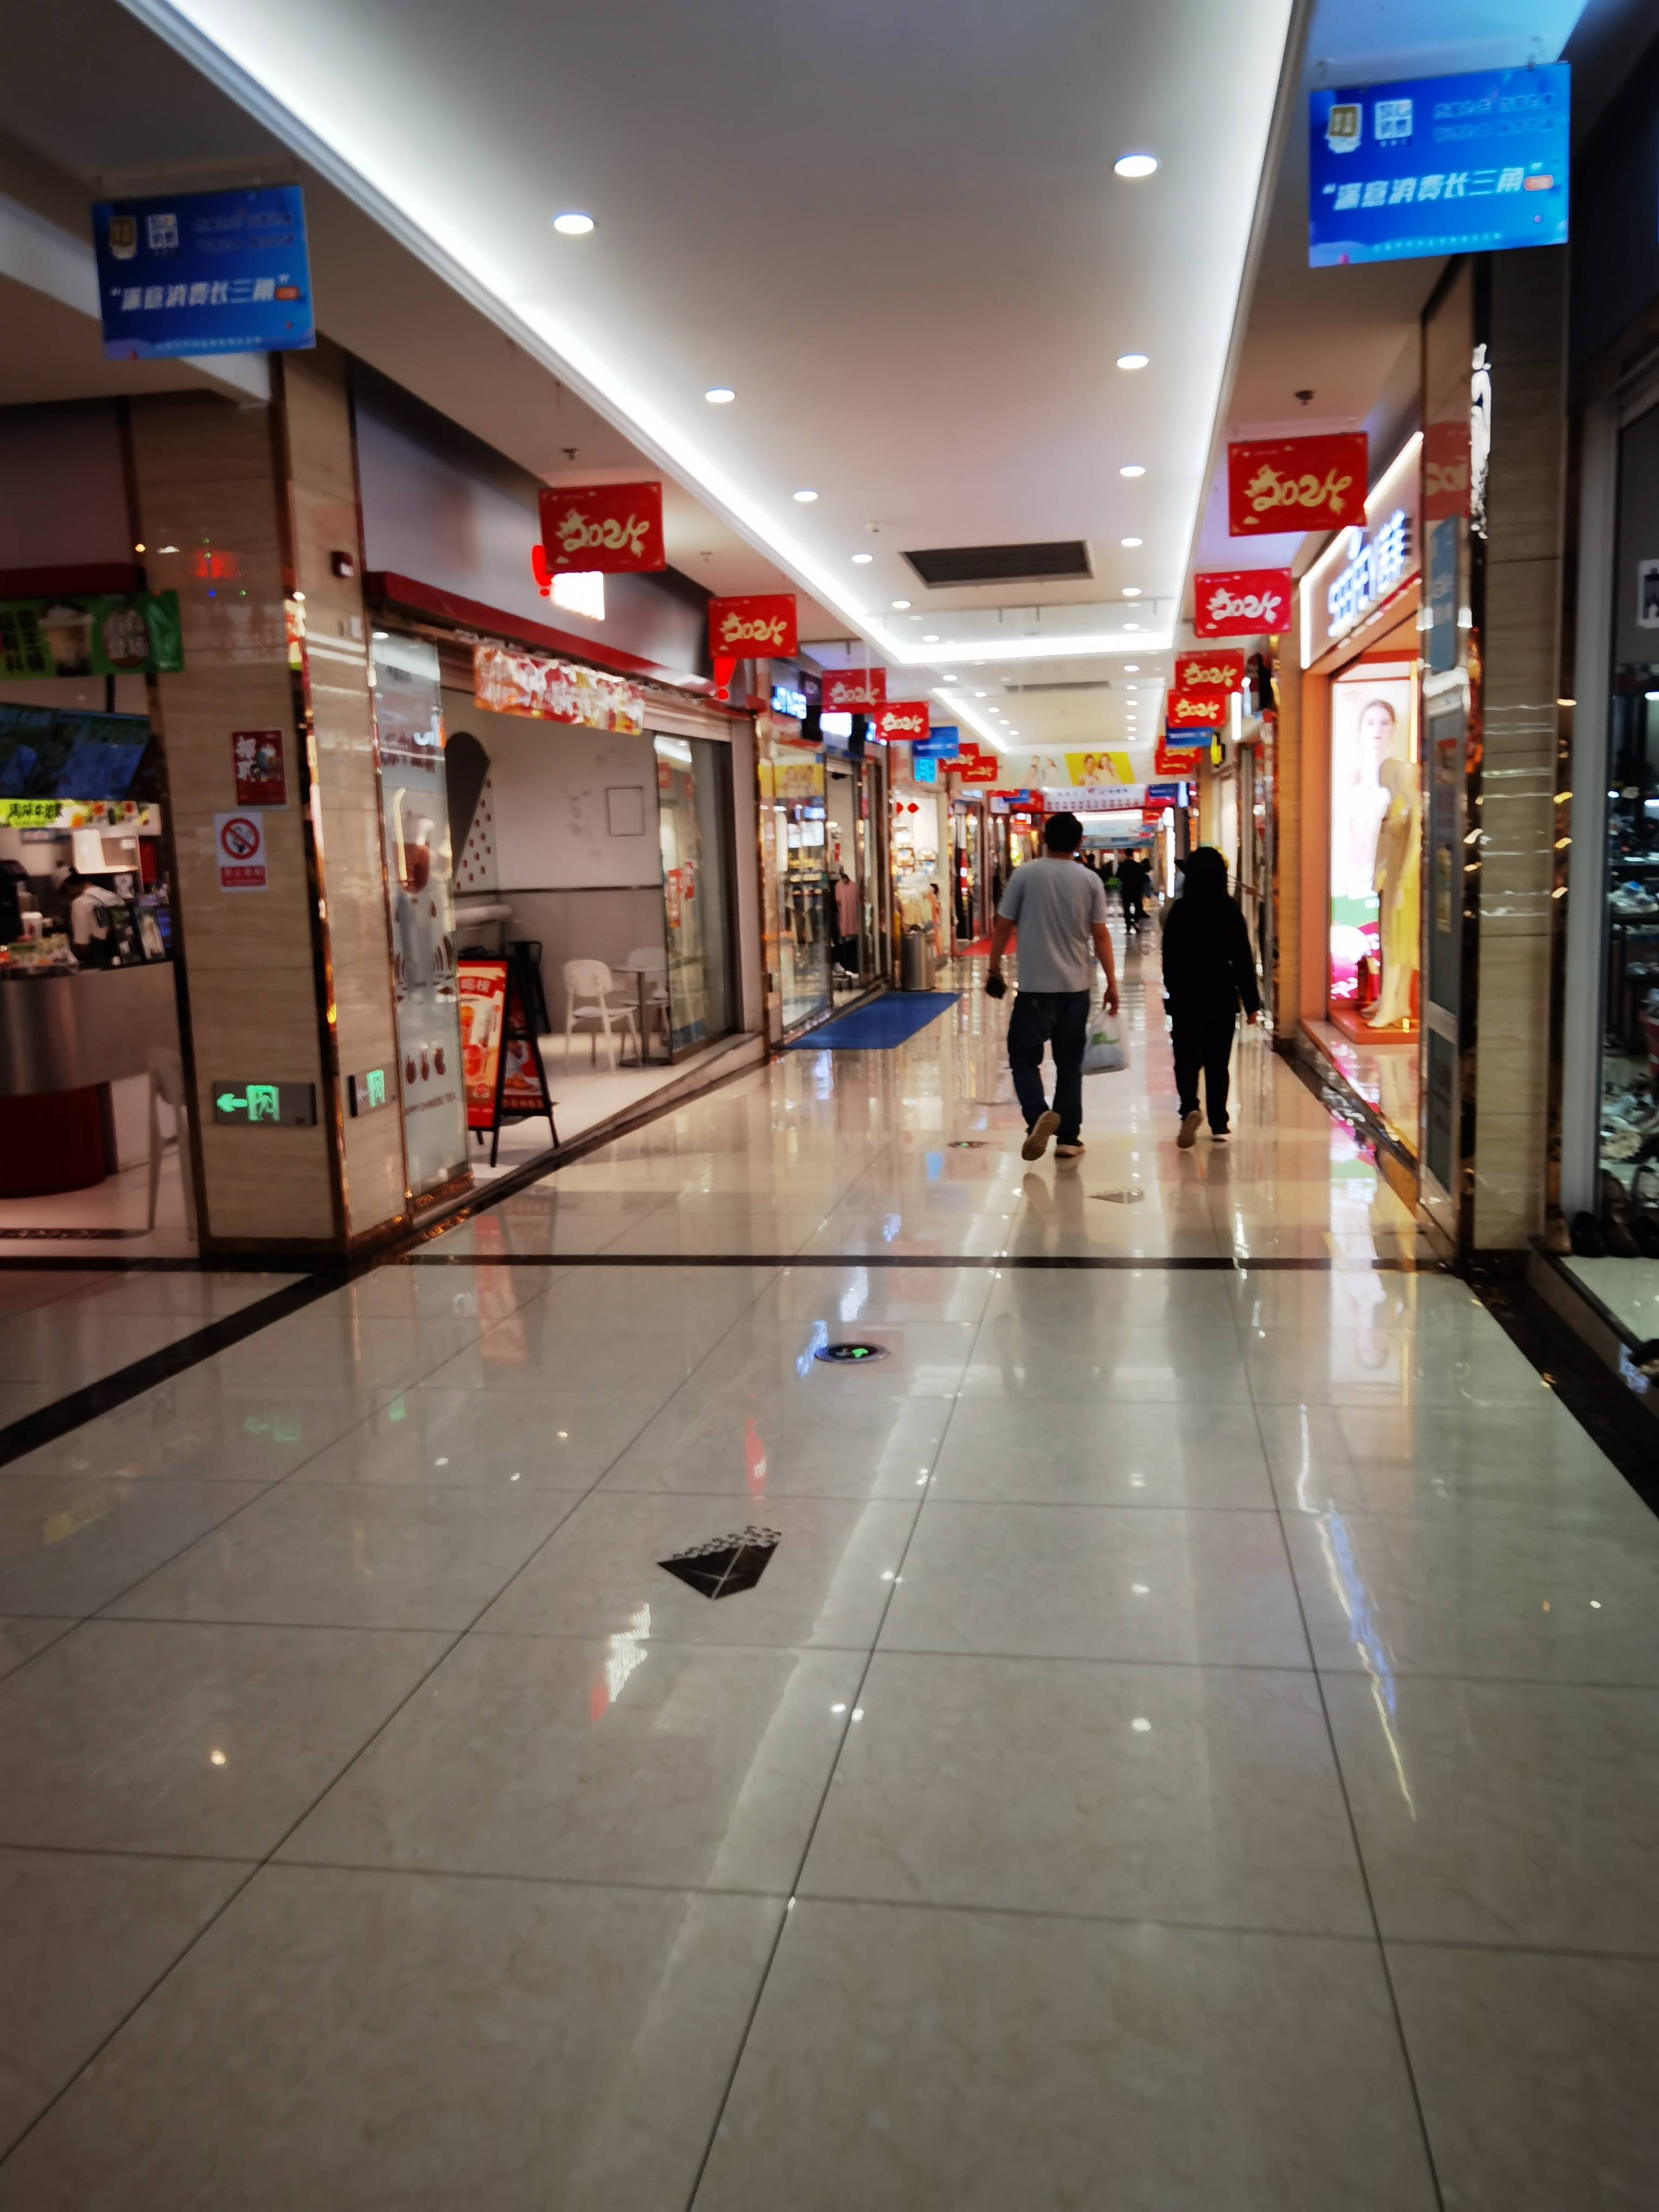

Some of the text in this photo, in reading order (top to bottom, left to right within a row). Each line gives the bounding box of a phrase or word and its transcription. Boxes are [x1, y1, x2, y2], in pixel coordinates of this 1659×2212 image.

[1244, 464, 1352, 515] 2024
[556, 509, 650, 557] 2024
[1206, 588, 1282, 623] 2024
[720, 612, 787, 646] 2024
